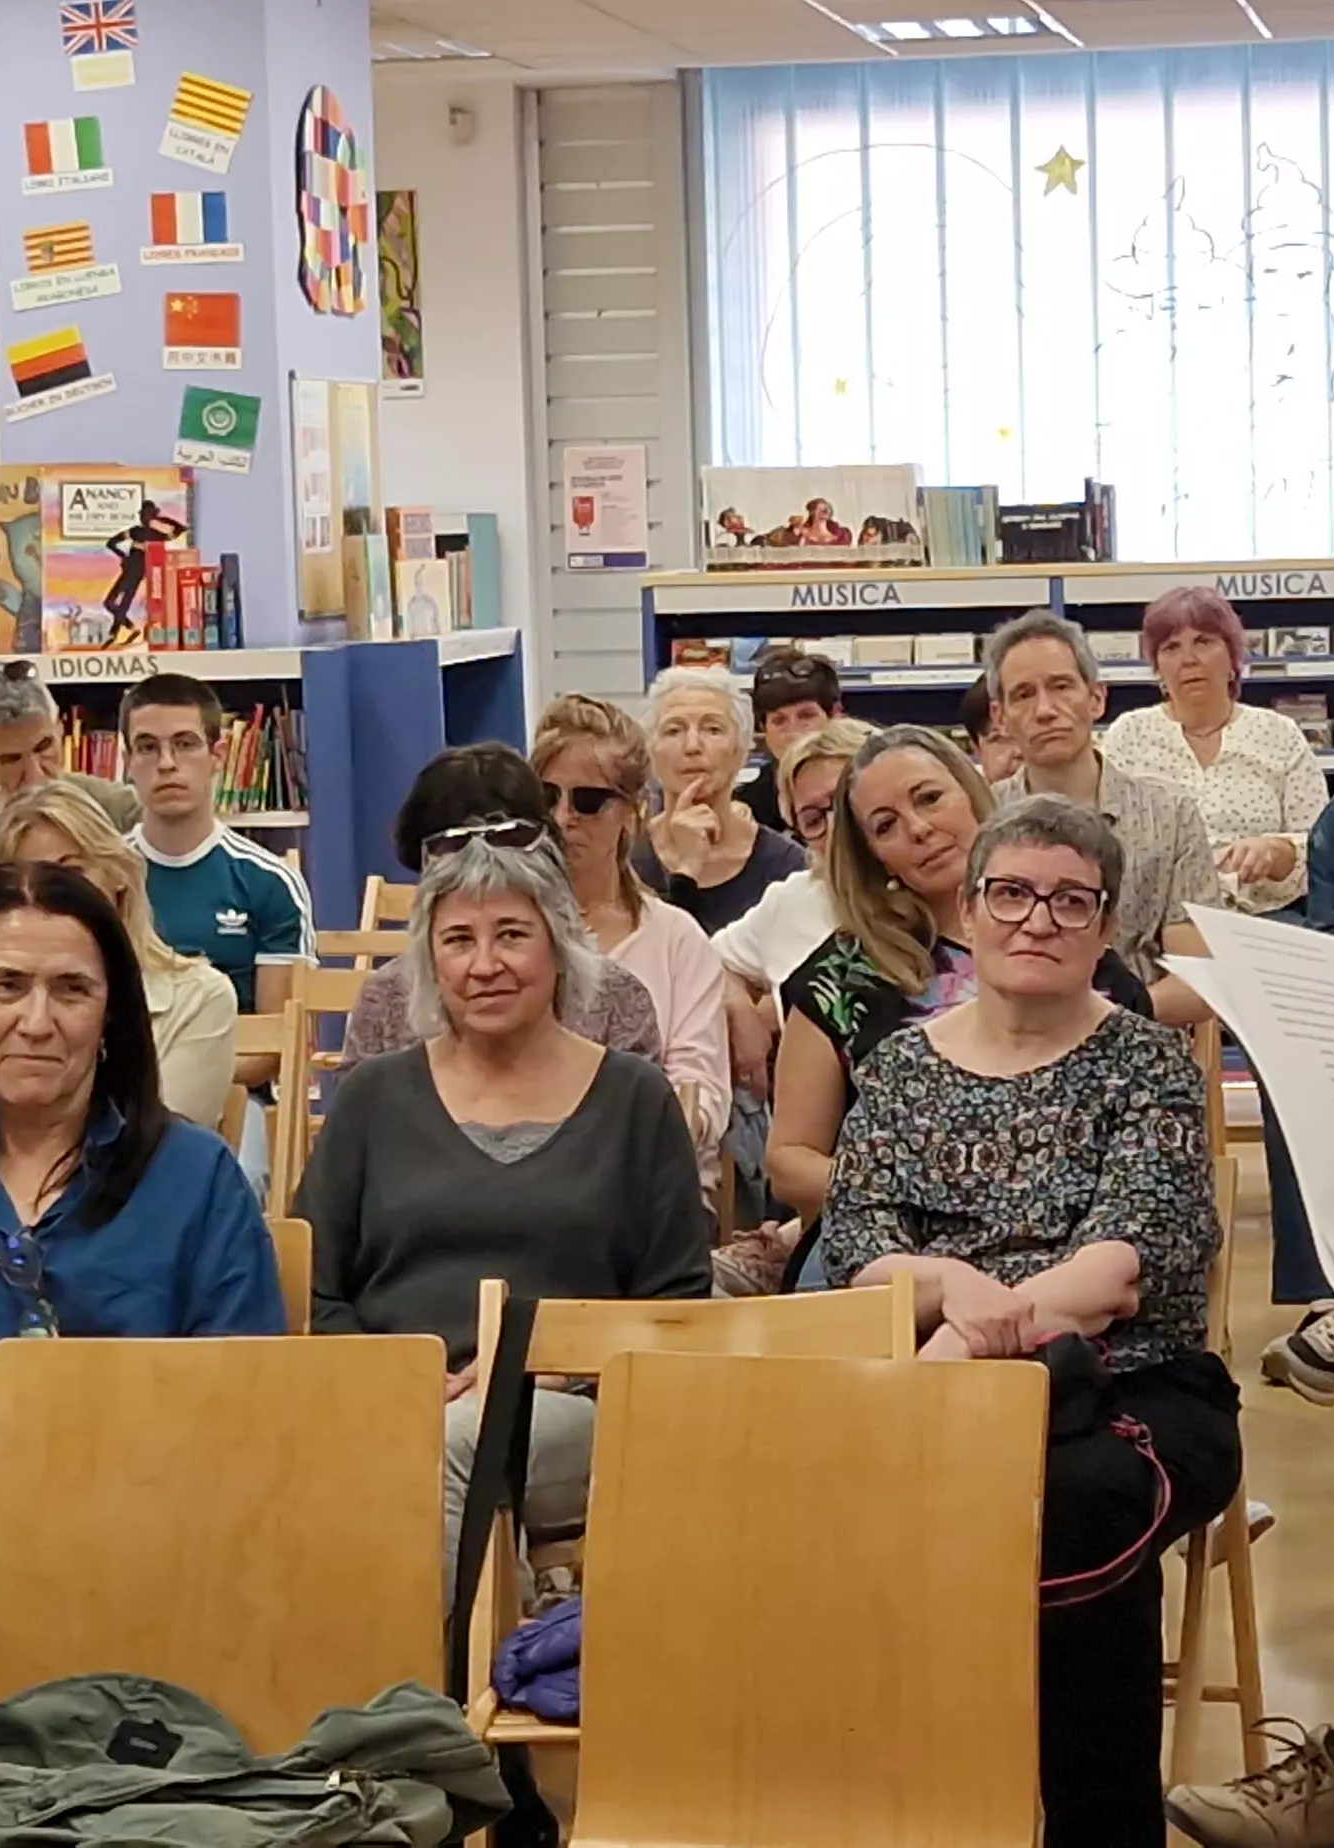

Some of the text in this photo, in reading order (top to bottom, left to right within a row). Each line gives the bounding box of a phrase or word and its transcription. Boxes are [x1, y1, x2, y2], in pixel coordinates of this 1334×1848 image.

[69, 487, 135, 510] ANANCY
[791, 583, 902, 607] MUSICA
[1214, 572, 1327, 596] MUSICA
[52, 654, 159, 678] IDIOMAS
